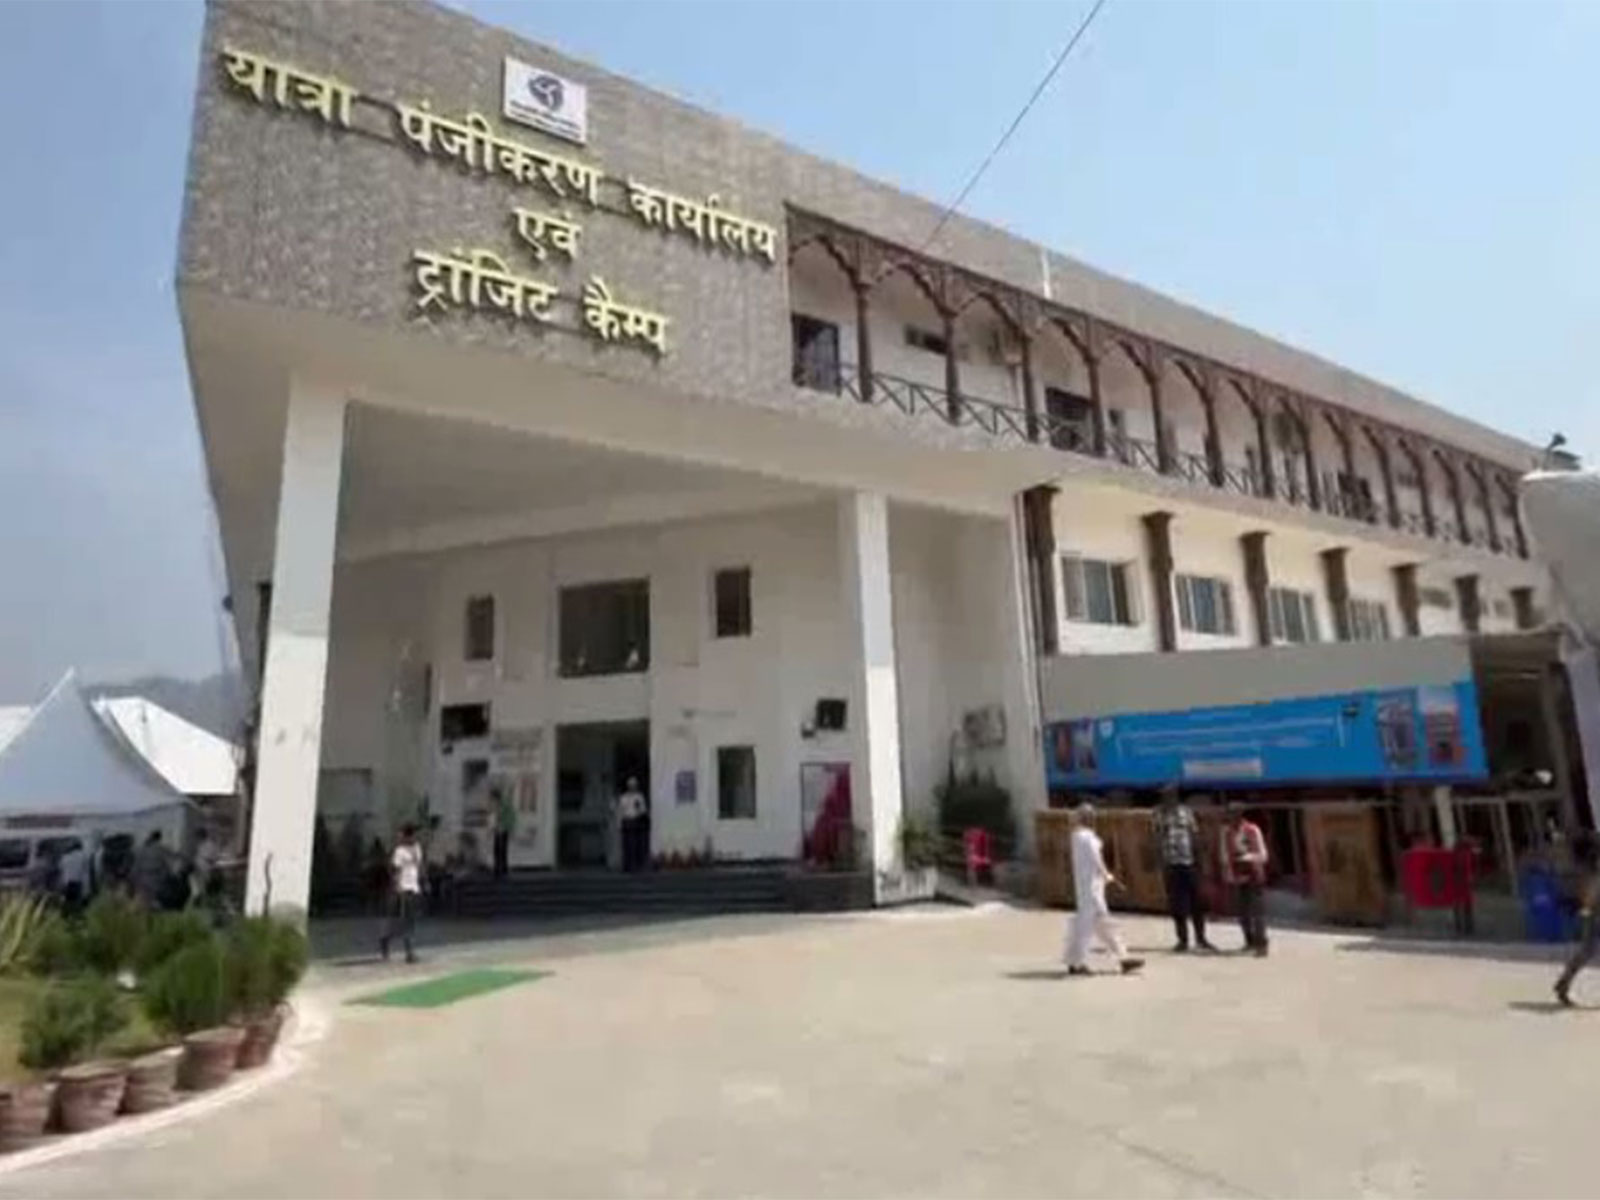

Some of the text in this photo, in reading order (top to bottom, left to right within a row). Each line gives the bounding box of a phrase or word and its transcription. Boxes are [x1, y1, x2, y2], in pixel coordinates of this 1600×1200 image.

[223, 46, 777, 262] यात्रा पंजीकरण कार्यालय
[513, 207, 581, 260] एवं
[413, 246, 669, 352] ट्रांजिट कैम्प
